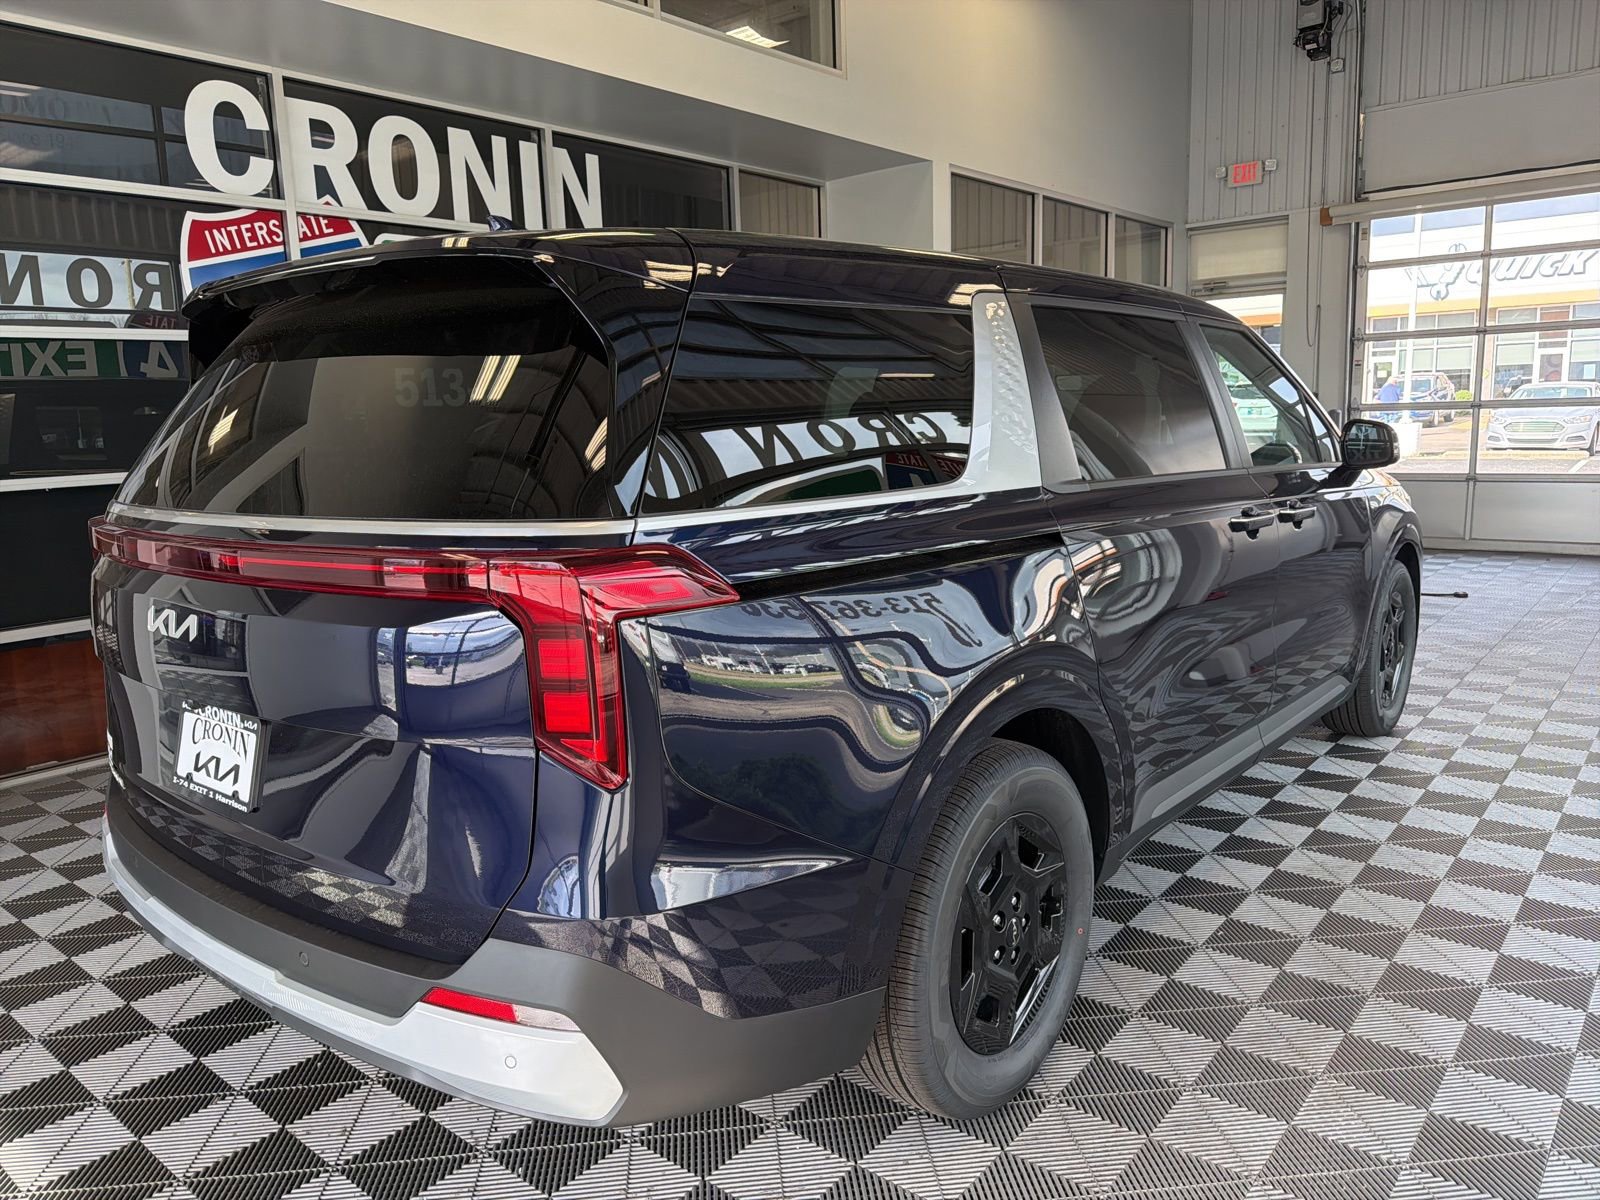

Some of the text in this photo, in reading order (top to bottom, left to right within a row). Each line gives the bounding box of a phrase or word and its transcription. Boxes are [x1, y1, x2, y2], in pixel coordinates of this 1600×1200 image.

[184, 79, 603, 230] CRONIN
[1232, 161, 1259, 184] EXIT
[204, 214, 335, 255] INTERSATE
[147, 605, 199, 643] KIA
[192, 717, 250, 762] CRONIN
[193, 751, 241, 787] KIA
[172, 776, 189, 788] I-74
[189, 783, 209, 796] EXIT
[215, 793, 248, 813] Harrison
